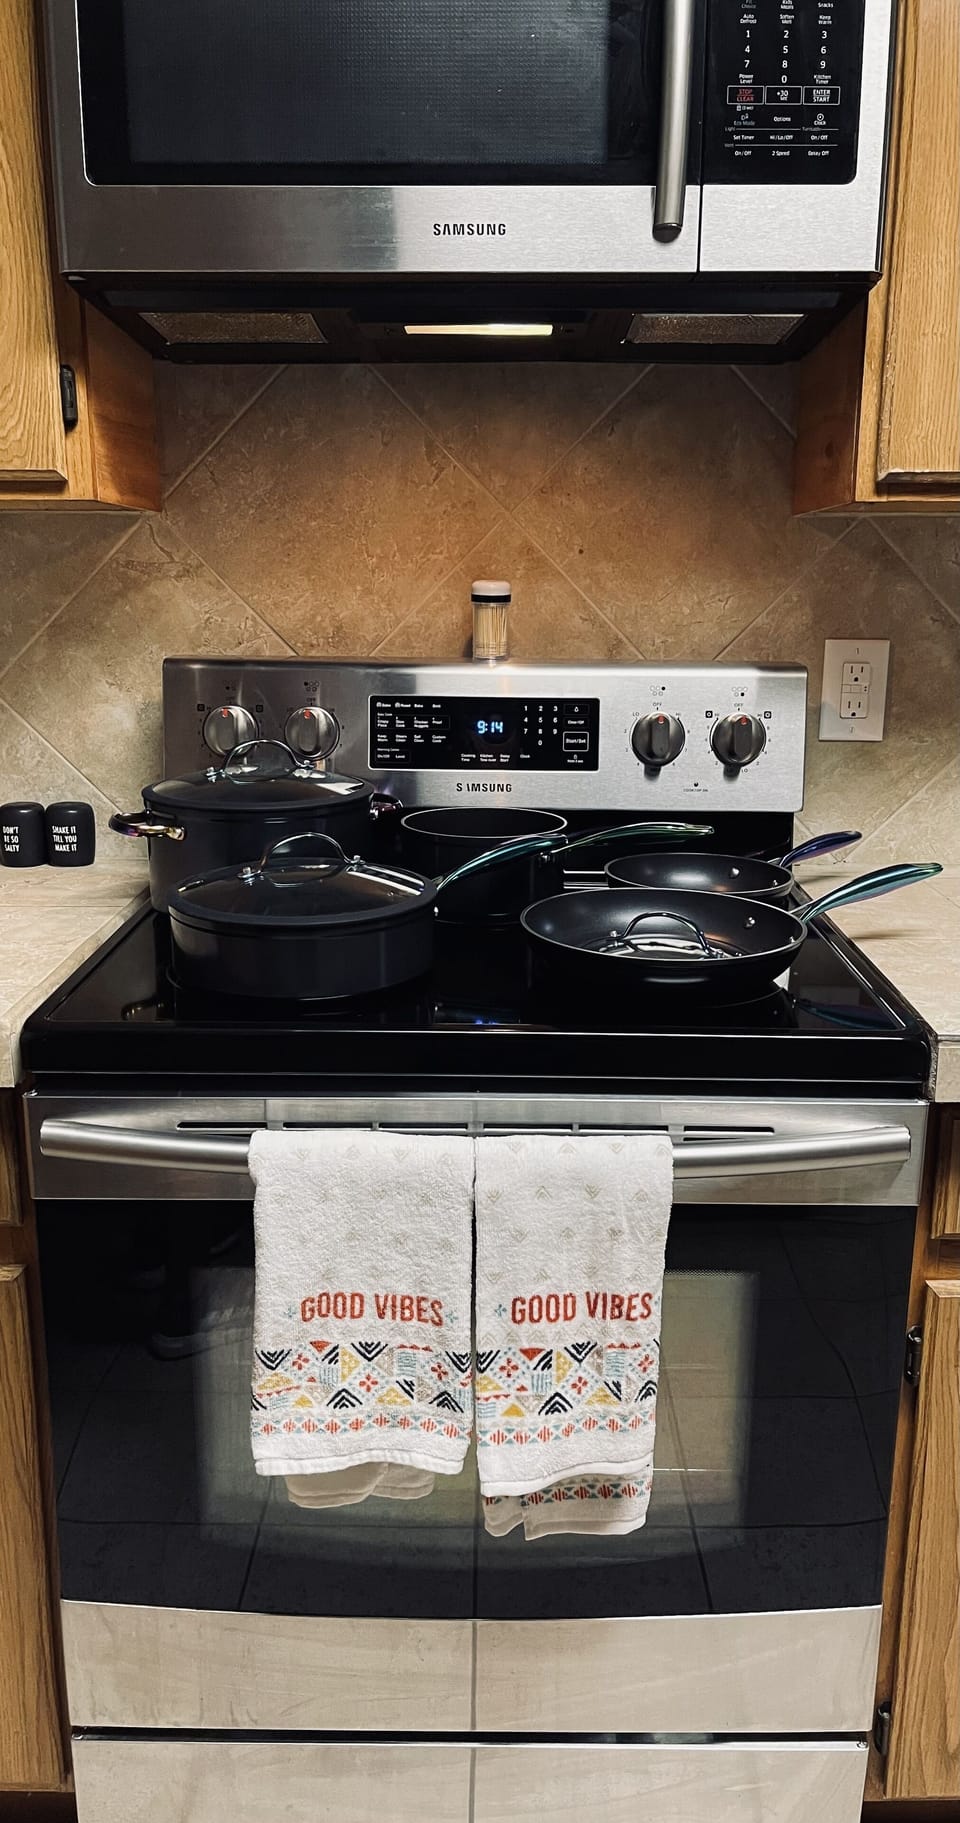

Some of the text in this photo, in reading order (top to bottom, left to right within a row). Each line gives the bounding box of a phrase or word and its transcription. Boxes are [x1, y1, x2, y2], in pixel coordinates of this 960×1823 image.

[784, 30, 789, 38] 2
[822, 30, 827, 38] 3
[782, 46, 788, 54] 5
[820, 46, 826, 54] 6
[744, 60, 750, 68] 7
[782, 60, 788, 68] 8
[820, 60, 826, 68] 9
[782, 75, 787, 83] 0
[433, 224, 506, 236] SAMSUNG
[477, 720, 503, 734] 9:14
[52, 826, 69, 834] SHAKE
[4, 844, 19, 852] SALTY
[301, 1292, 445, 1327] GOOD VIBES
[511, 1291, 653, 1325] GOOD VIBES
